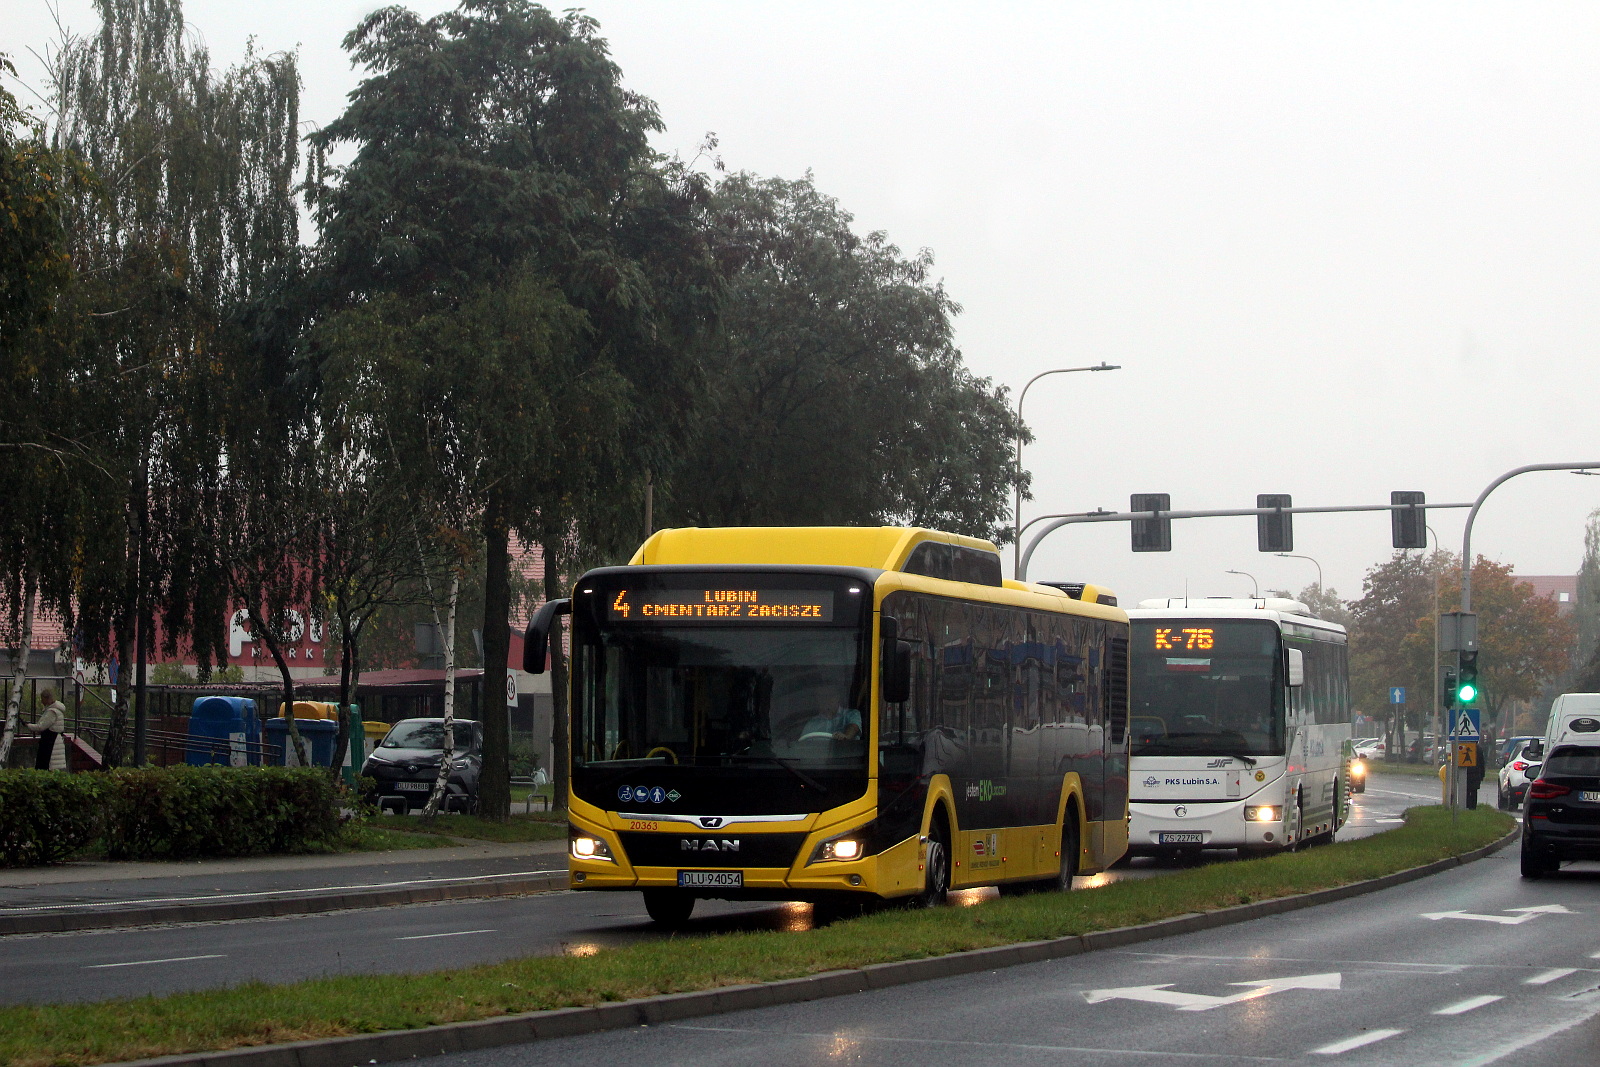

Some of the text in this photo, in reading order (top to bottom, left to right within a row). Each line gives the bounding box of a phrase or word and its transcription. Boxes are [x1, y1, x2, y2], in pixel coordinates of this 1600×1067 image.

[705, 590, 757, 602] LUBIN
[613, 590, 630, 618] 4
[642, 604, 822, 617] CMENTARZ ZACISZE
[1156, 628, 1214, 649] K-76
[1182, 777, 1204, 785] Lubin
[1584, 791, 1598, 800] DLU
[630, 821, 658, 831] 20363
[680, 839, 740, 851] MAN
[684, 873, 741, 885] DLU 94054
